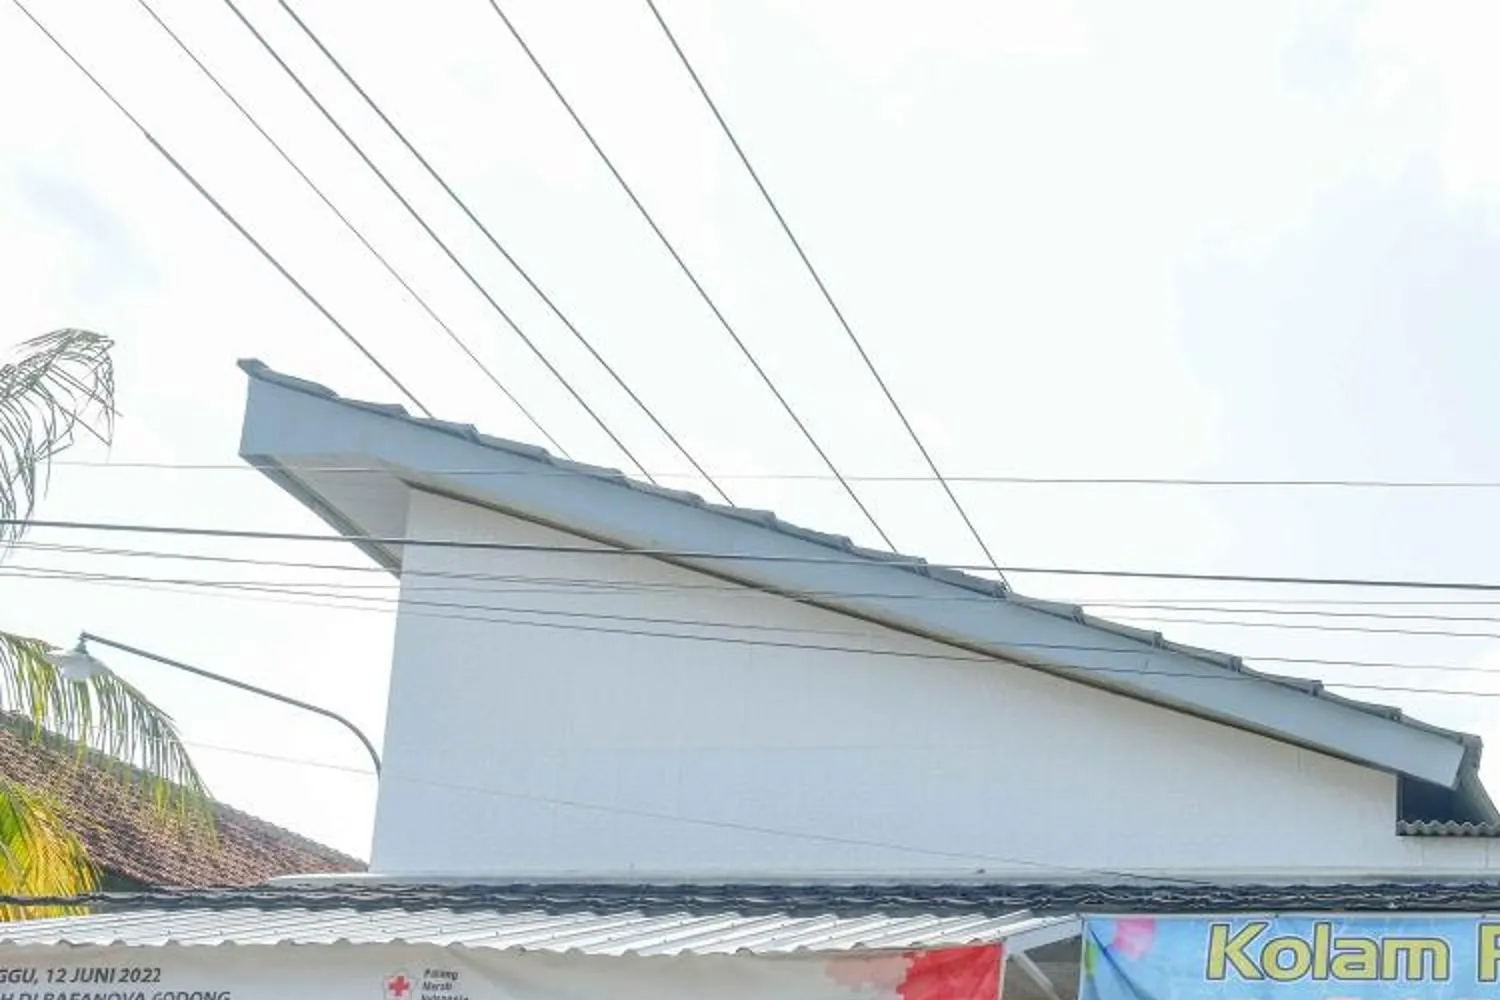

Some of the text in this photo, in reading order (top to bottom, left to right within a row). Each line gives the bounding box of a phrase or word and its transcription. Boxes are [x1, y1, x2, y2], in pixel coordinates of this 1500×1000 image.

[1205, 921, 1450, 982] Kolam
[47, 968, 68, 983] 12
[70, 968, 115, 983] JUNI
[118, 968, 161, 983] 2022
